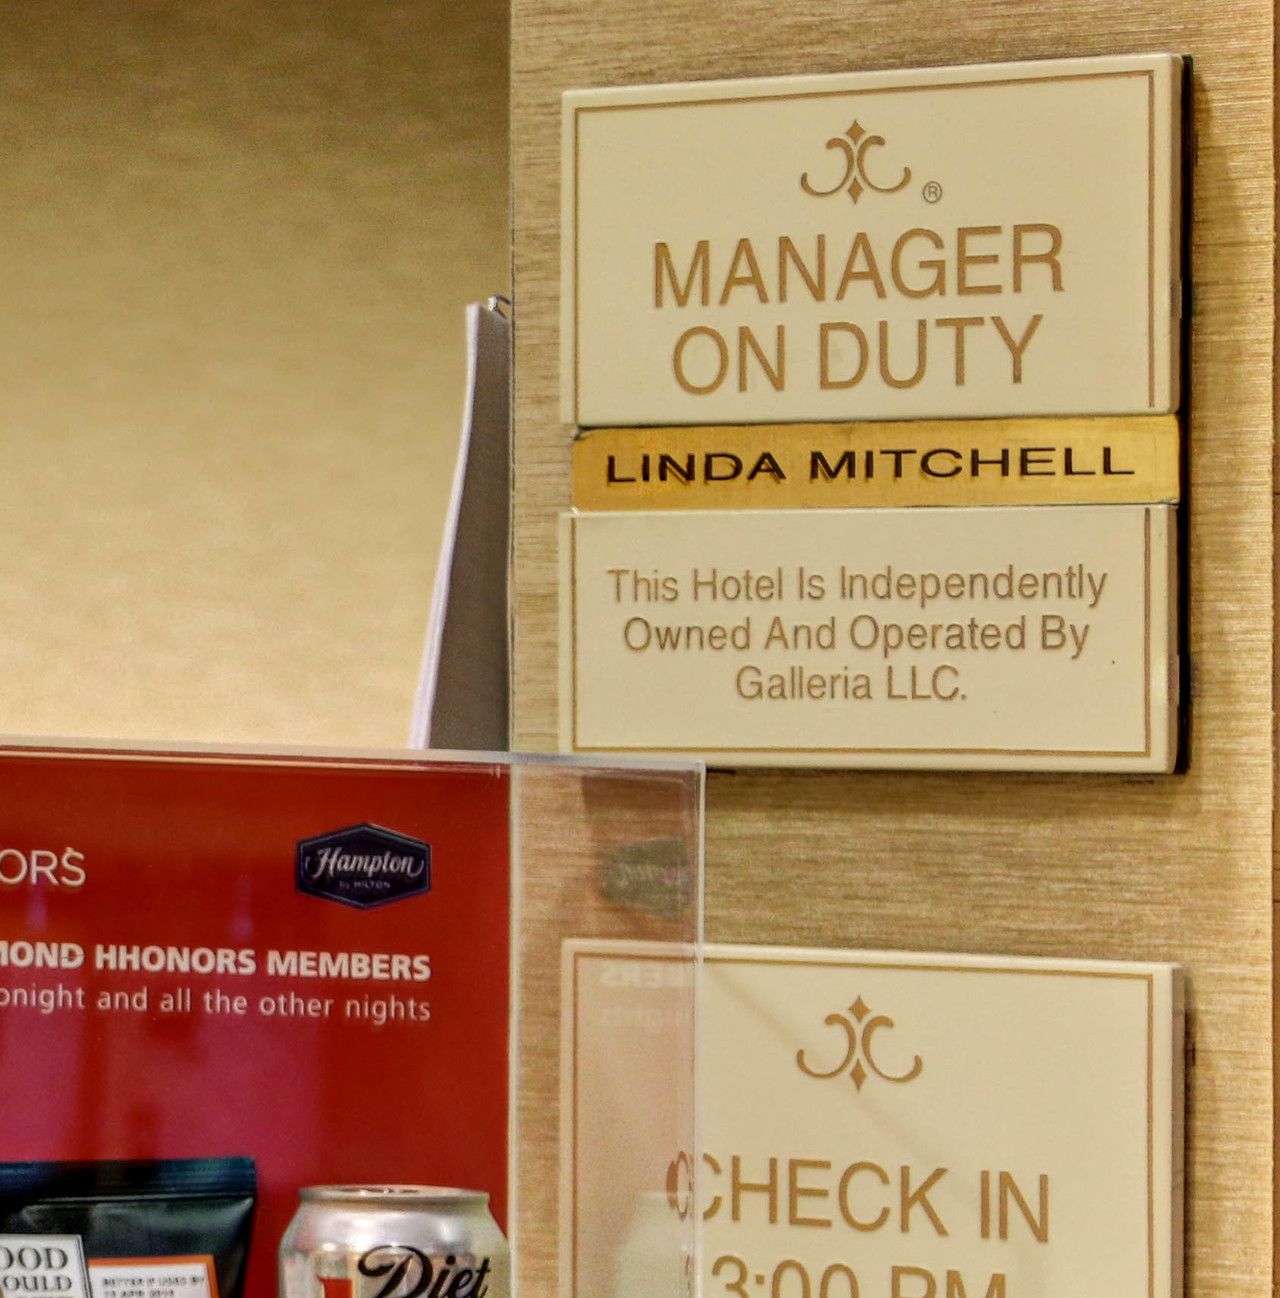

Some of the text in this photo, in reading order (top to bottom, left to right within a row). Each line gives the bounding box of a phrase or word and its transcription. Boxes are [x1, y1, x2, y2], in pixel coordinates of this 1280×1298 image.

[654, 223, 1065, 308] MANAGER
[673, 313, 1044, 395] ON DUTY
[606, 446, 1136, 484] LINDA MITCHELL
[607, 563, 1107, 607] This Hotel Is Independently
[624, 613, 1090, 658] Owned And Operated By
[737, 664, 968, 701] Galleria LLC.
[305, 848, 424, 884] Hampton
[95, 943, 256, 976] HHONORS
[267, 950, 432, 982] MEMBERS
[96, 986, 148, 1013] and
[160, 987, 191, 1013] all
[204, 989, 248, 1016] the
[259, 991, 334, 1018] other
[345, 994, 431, 1026] nights
[667, 1151, 1050, 1244] CHECK IN
[3, 1274, 72, 1292] OULD
